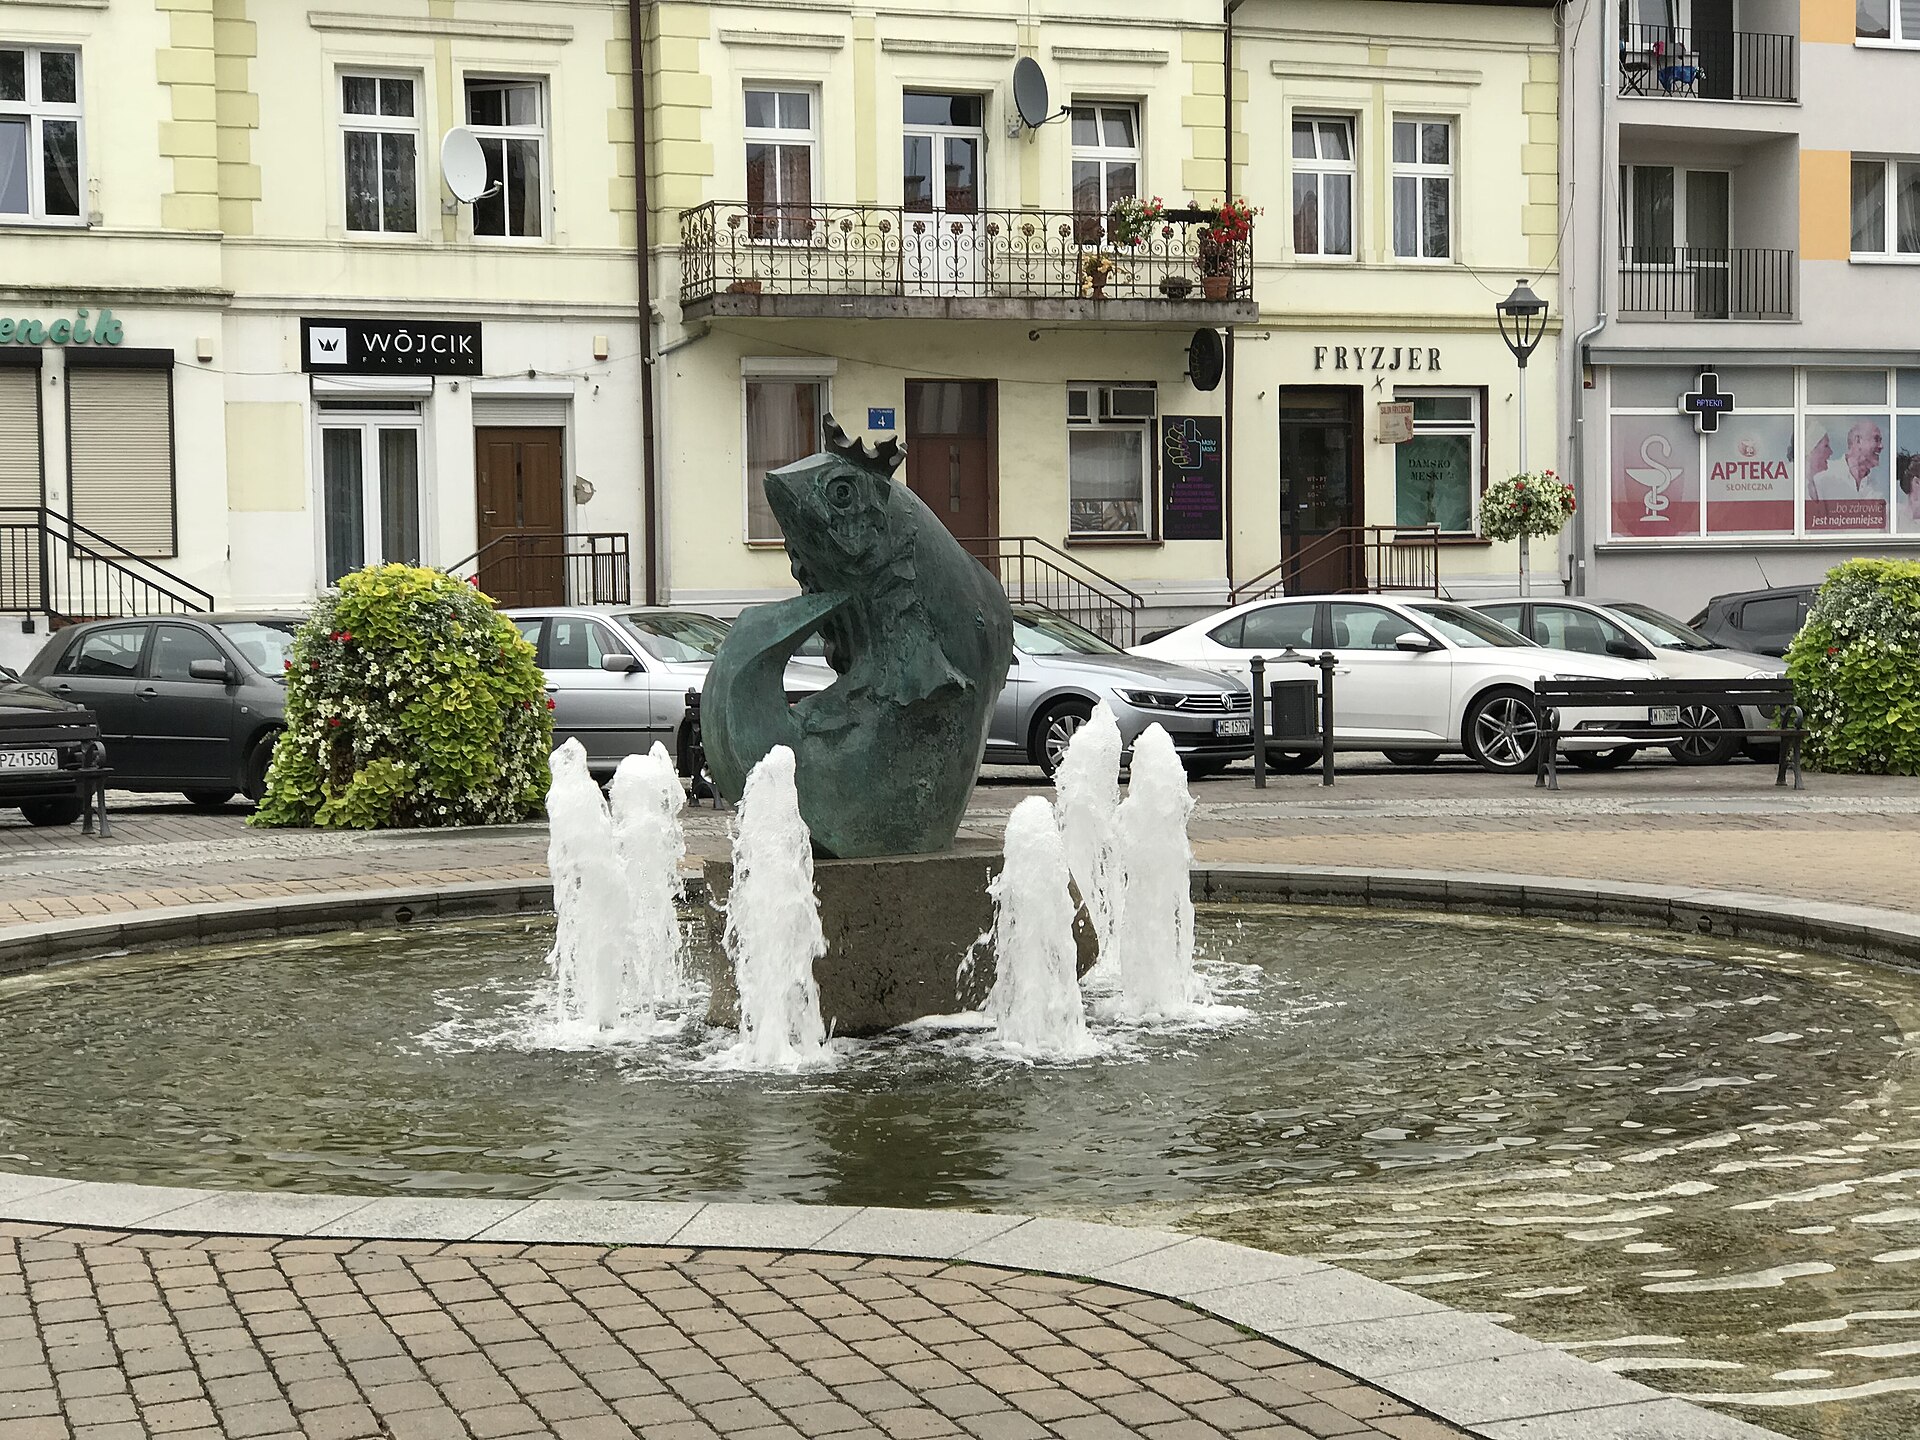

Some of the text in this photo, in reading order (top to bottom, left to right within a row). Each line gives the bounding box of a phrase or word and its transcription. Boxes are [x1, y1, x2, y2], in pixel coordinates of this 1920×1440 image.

[362, 356, 474, 365] FASHION
[1313, 345, 1442, 371] FRYZJER
[1696, 399, 1723, 407] APTEKA
[877, 415, 886, 427] 4
[1710, 461, 1789, 480] APTEKA
[1726, 483, 1773, 491] SŁONECZNA
[1849, 502, 1883, 514] zdrowie
[1812, 514, 1883, 527] jest najcenniejsze
[0, 751, 56, 768] PZ 15506
